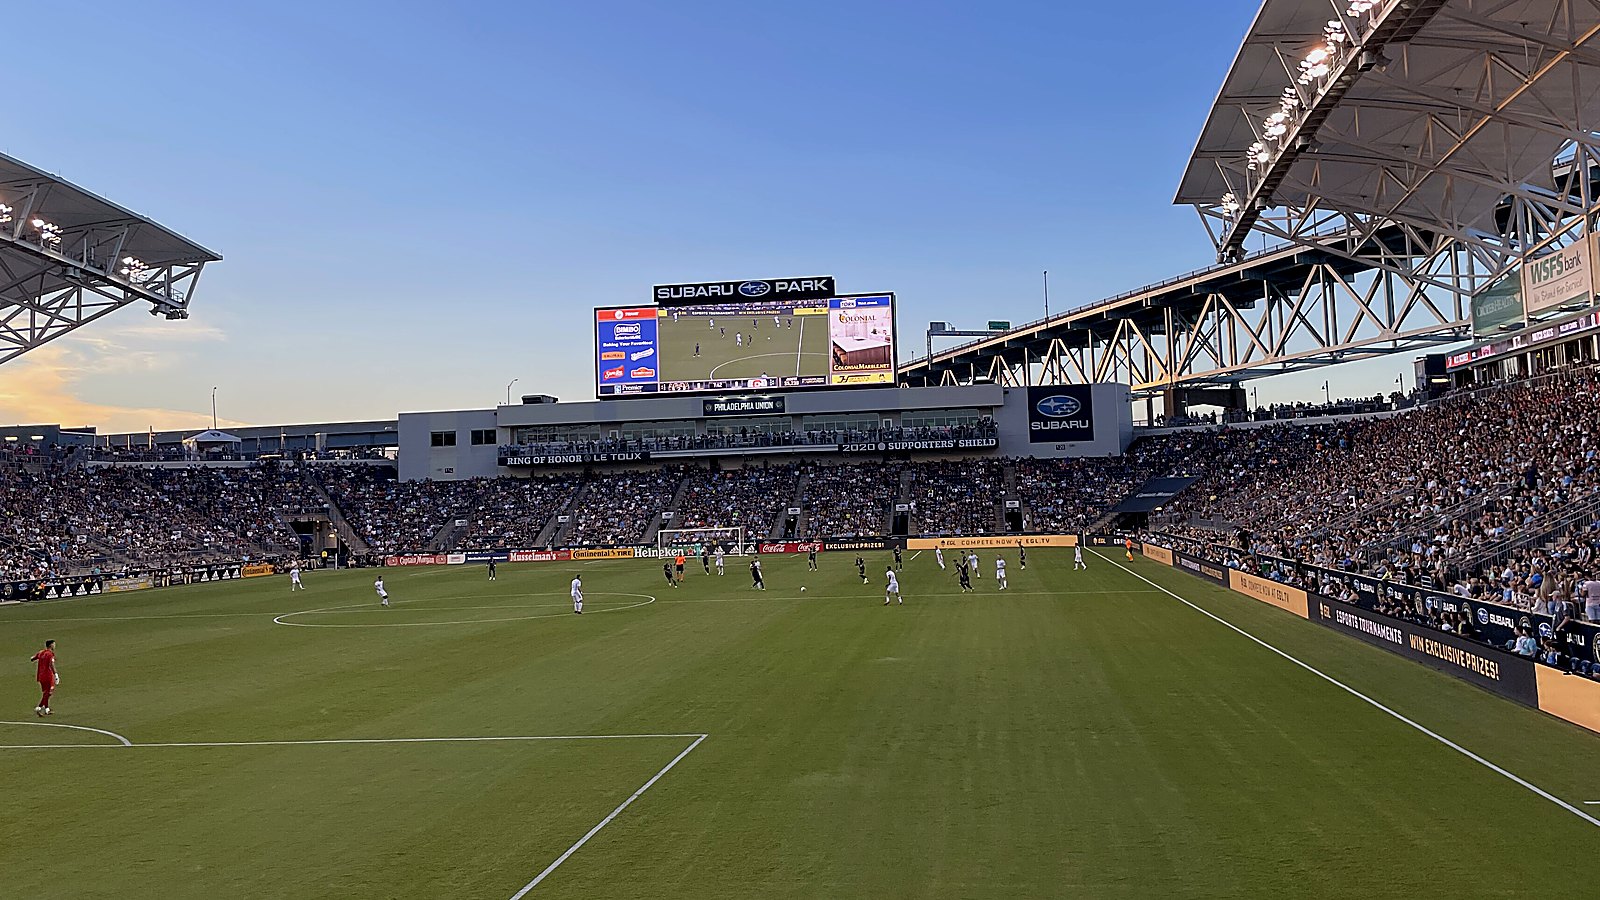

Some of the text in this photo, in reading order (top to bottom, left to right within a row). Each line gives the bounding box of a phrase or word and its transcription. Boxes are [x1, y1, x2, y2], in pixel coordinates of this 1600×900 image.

[1530, 250, 1581, 285] WSFS bank
[657, 279, 828, 299] SUBARU PARK
[839, 313, 877, 324] COLONIAL
[714, 401, 774, 412] PHILADELPHIA UNION
[1031, 419, 1089, 430] SUBARU
[842, 438, 996, 451] 2020 SUPPORTERS' SHIELD
[507, 457, 531, 465] RING
[533, 456, 546, 464] OF
[548, 455, 582, 463] HONOR
[510, 552, 556, 562] Musselman's
[573, 550, 610, 559] Continental
[634, 547, 684, 558] Heineken
[400, 555, 435, 565] Captain Morgan
[1489, 613, 1514, 629] SUBARU
[1336, 609, 1359, 629] ESPORTS
[1359, 617, 1403, 645] TOURNAMENTS
[1409, 633, 1425, 652] WIN
[1425, 638, 1466, 667] EXCLUSIVE
[1466, 652, 1500, 681] PRIZES!
